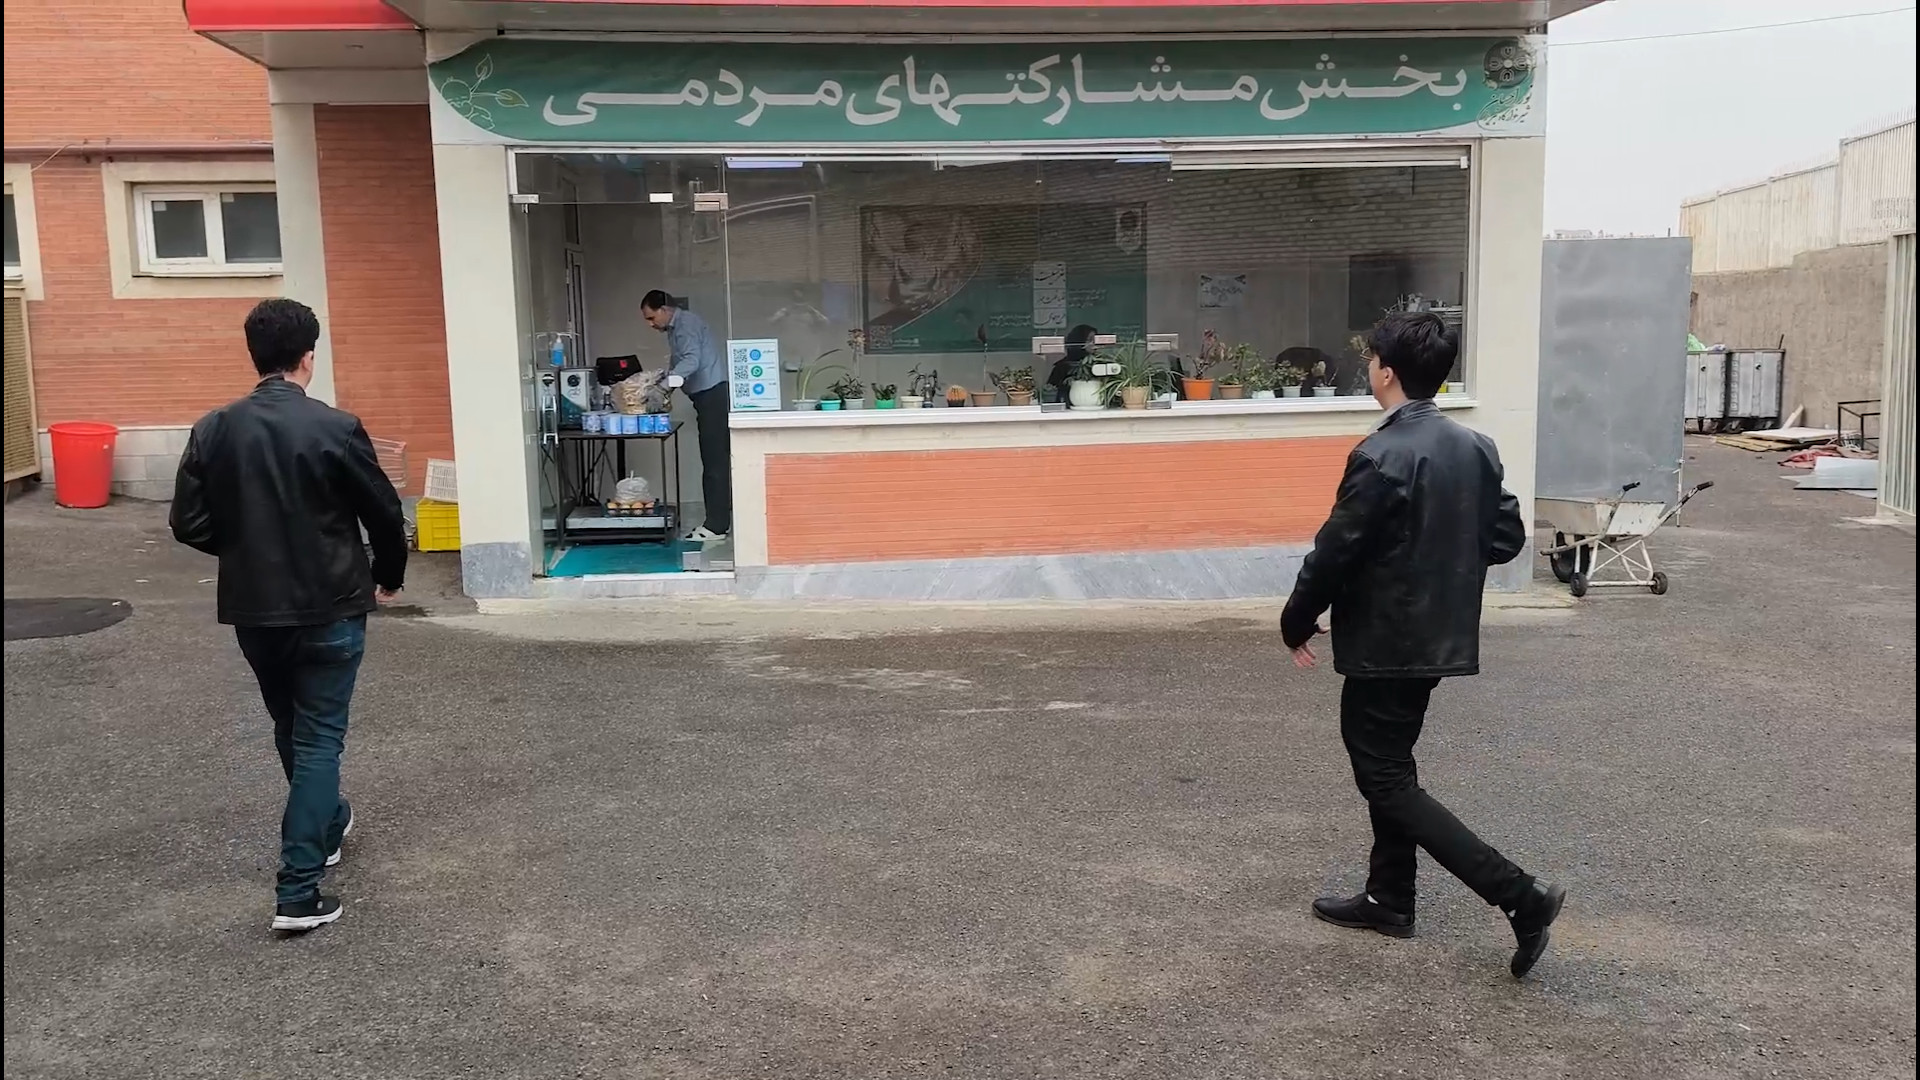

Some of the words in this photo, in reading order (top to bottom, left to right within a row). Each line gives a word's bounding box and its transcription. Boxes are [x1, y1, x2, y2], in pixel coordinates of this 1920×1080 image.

[542, 68, 843, 127] مردمی
[844, 54, 1259, 127] مشارکتهای
[1260, 53, 1468, 121] بخش
